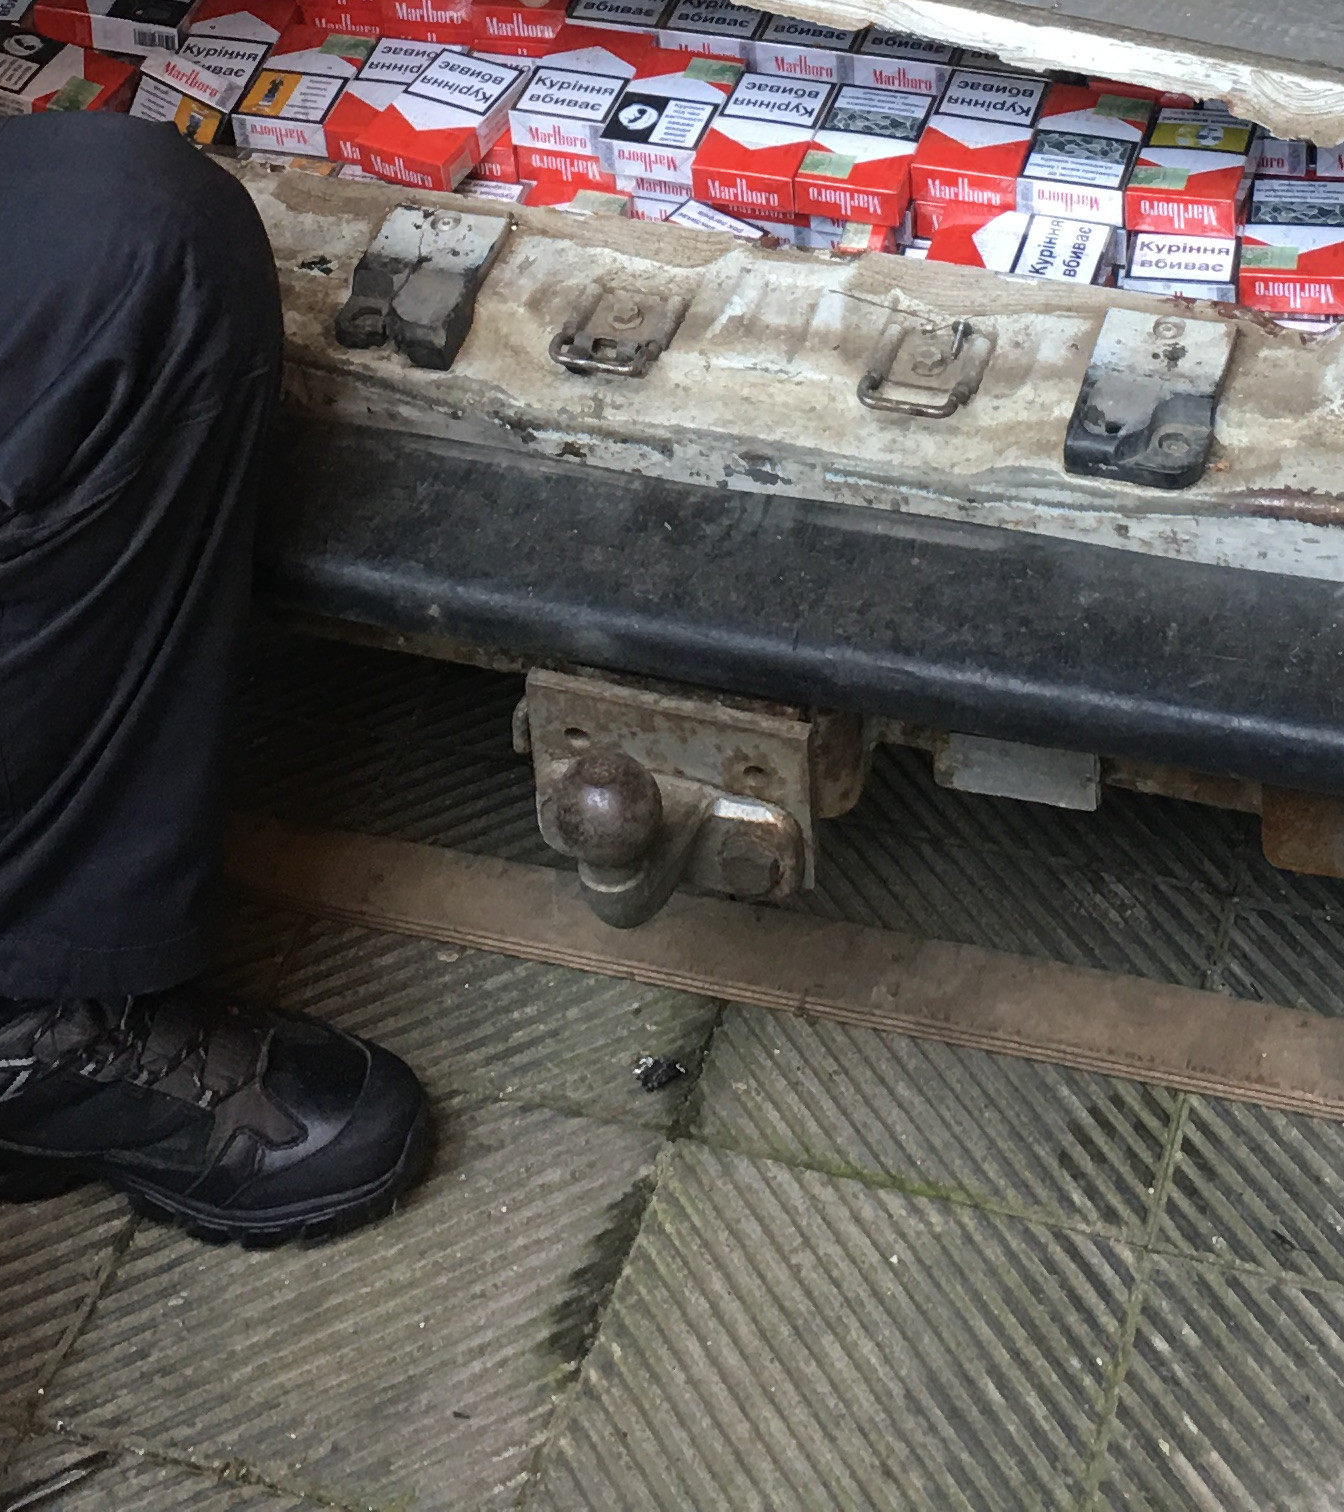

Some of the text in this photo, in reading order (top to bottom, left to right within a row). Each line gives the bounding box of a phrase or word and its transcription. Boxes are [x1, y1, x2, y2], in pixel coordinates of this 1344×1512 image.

[485, 12, 554, 39] Marlboro
[677, 11, 751, 29] вбиває
[773, 23, 848, 41] вбиває
[182, 42, 260, 63] Куріння
[380, 45, 439, 62] биває
[872, 35, 946, 55] вбиває
[368, 60, 424, 75] ріння
[438, 59, 506, 86] вбиває
[774, 54, 833, 79] Marlboro
[163, 60, 219, 99] Marlboro
[419, 74, 495, 105] Куріння
[534, 74, 616, 97] Куріння
[744, 81, 821, 100] вбиває
[872, 67, 933, 92] Marlboro
[958, 79, 1035, 98] вбиває
[527, 93, 603, 113] вбиває
[732, 96, 815, 119] Куріння
[946, 95, 1031, 117] Куріння
[251, 122, 308, 147] Marlboro
[528, 124, 588, 148] Marlboro
[370, 154, 433, 188] Marlboro
[532, 152, 602, 182] Marlboro
[618, 148, 678, 173] Marlboro
[707, 177, 779, 207] Marlboro
[808, 186, 882, 216] Marlboro
[927, 176, 1001, 206] Marlboro
[1038, 188, 1100, 213] Marlboro
[1139, 199, 1218, 230] Marlboro
[1028, 217, 1065, 276] Куріння
[1062, 226, 1093, 278] вбиває
[1138, 240, 1231, 257] Куріння
[1139, 258, 1225, 273] вбиває
[1255, 280, 1335, 309] Marlboro
